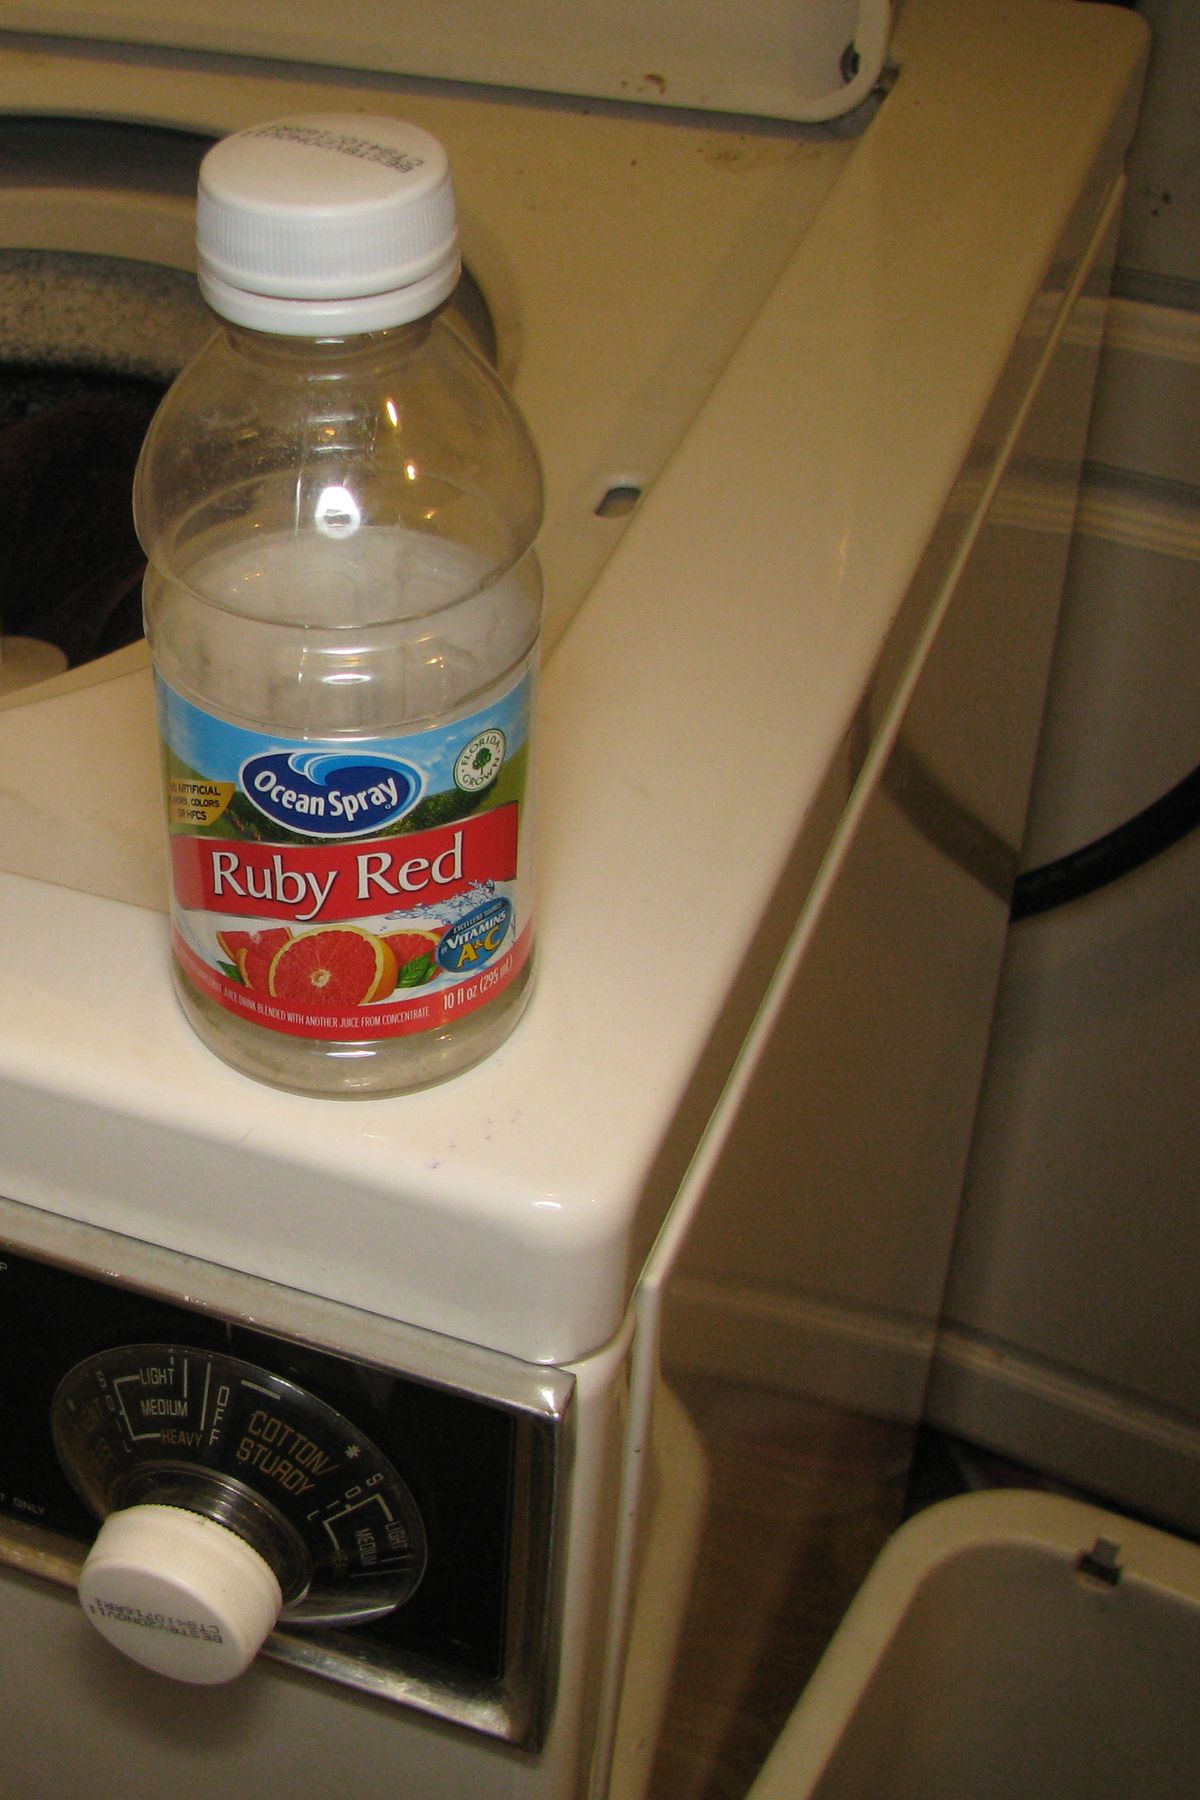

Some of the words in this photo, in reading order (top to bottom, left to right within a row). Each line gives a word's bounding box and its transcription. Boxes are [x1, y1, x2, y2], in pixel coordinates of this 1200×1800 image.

[461, 735, 501, 766] FLORIDA
[462, 757, 500, 787] GROWN
[190, 798, 220, 808] COLORS
[254, 770, 325, 817] Ocean
[330, 776, 399, 822] Spray
[211, 851, 339, 922] Ruby
[357, 831, 464, 900] Red
[446, 910, 506, 950] VITAMINS
[443, 992, 454, 1010] 10
[466, 984, 477, 1001] oz
[257, 1001, 286, 1020] BLENDED
[287, 1010, 304, 1025] WITH
[305, 1015, 338, 1028] ANOTHER
[340, 1016, 360, 1028] JUICE
[361, 1014, 381, 1028] FROM
[382, 1006, 431, 1026] CONCENTRATE
[140, 1367, 174, 1385] LIGHT
[141, 1399, 188, 1417] MEDIUM
[209, 1385, 230, 1446] OFF
[161, 1429, 203, 1447] HEAVY
[236, 1437, 316, 1496] STURDY
[13, 1496, 46, 1515] ONLY
[355, 1527, 377, 1565] MEDIUM
[385, 1520, 408, 1549] LIGHT
